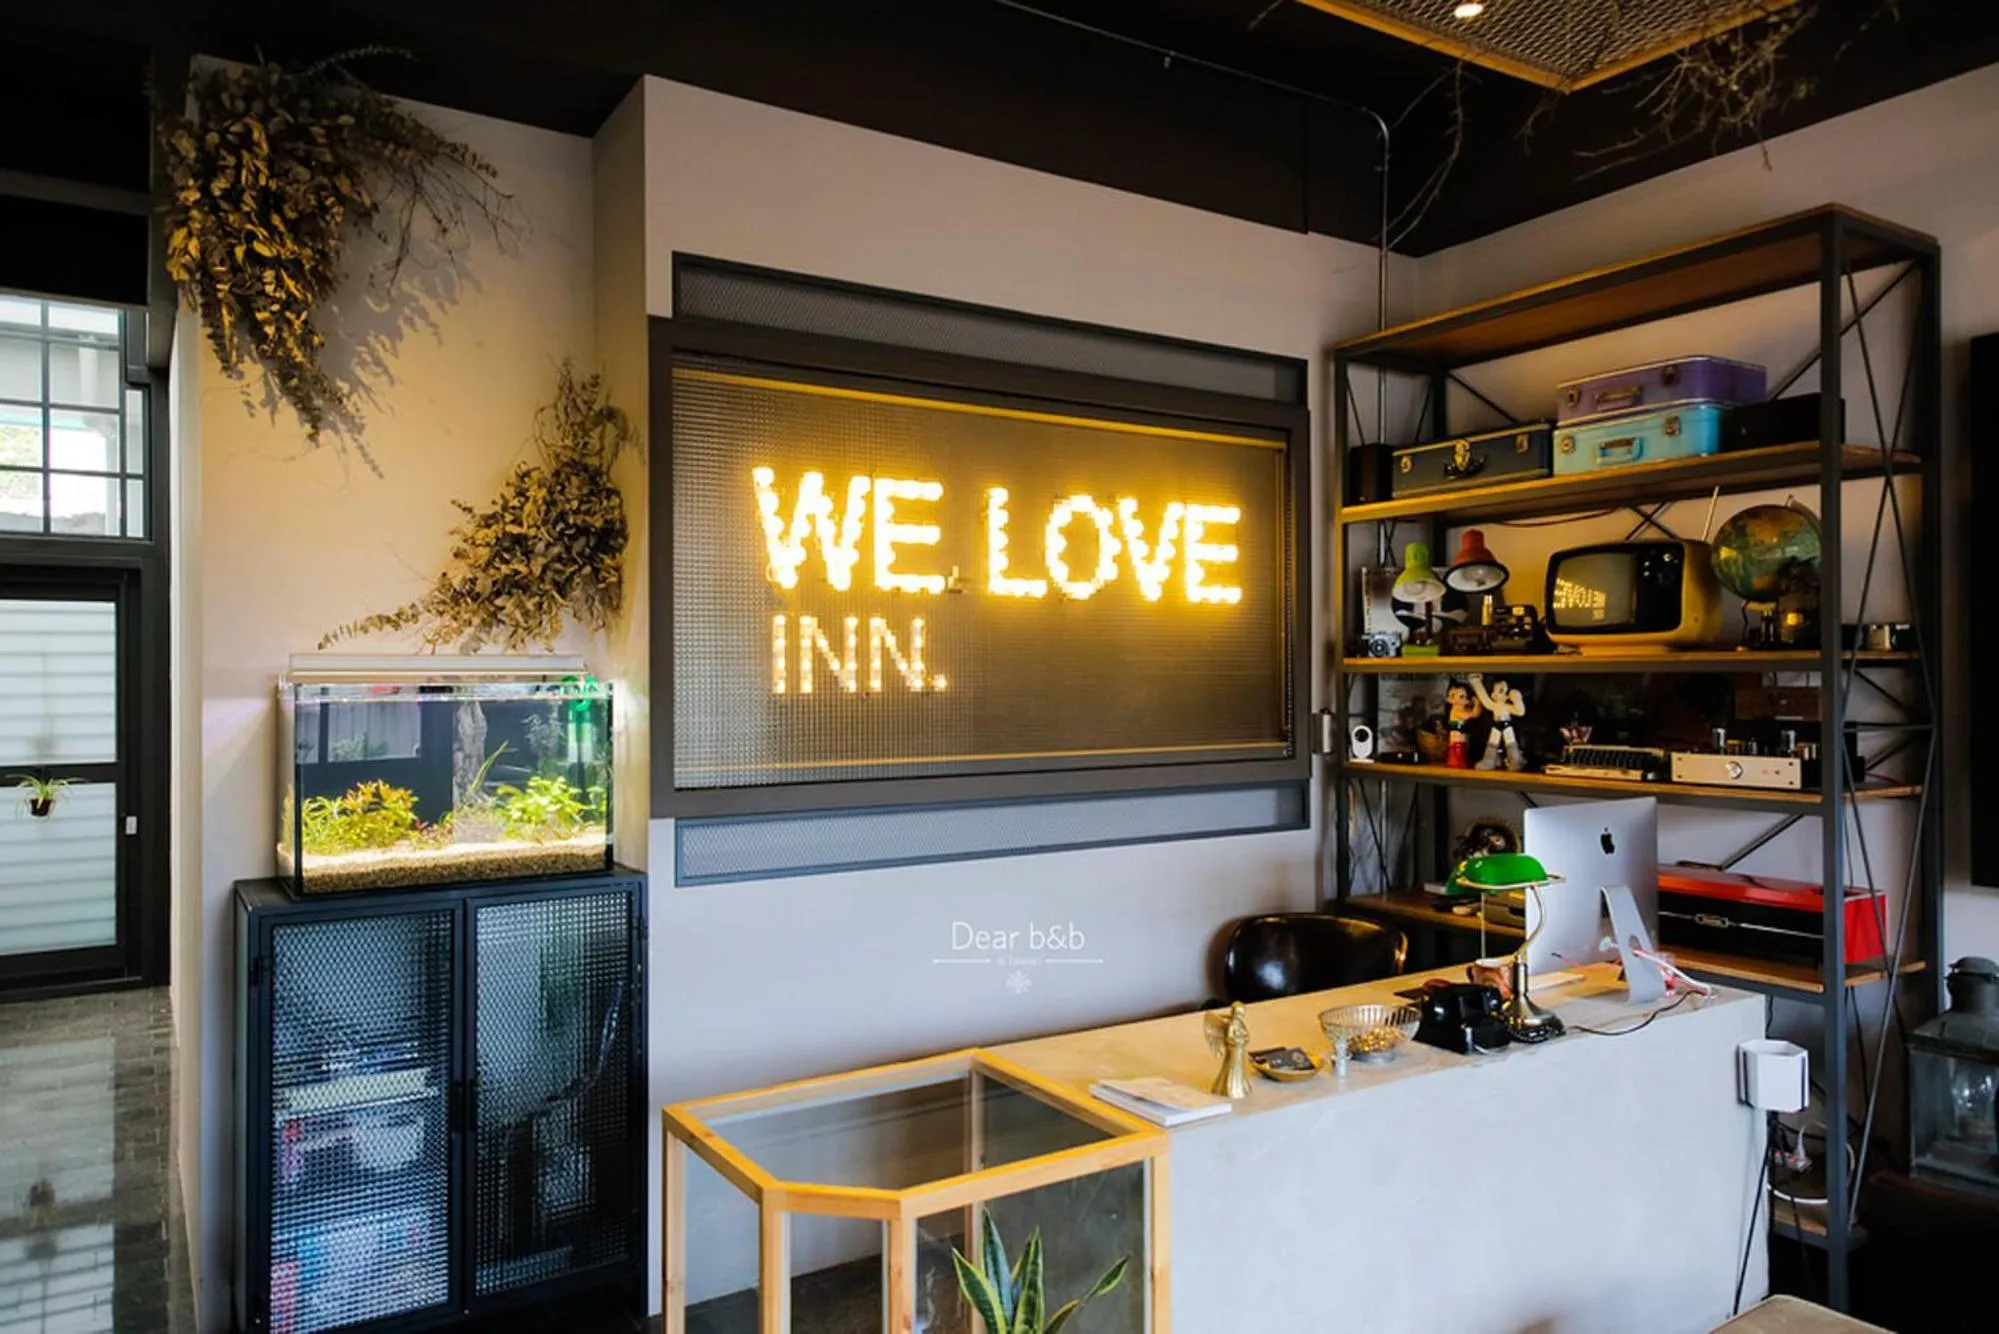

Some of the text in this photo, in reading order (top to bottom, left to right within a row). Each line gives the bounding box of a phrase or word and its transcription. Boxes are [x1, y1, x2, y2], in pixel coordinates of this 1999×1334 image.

[752, 466, 1242, 604] WE LOVE
[771, 614, 948, 694] INN.
